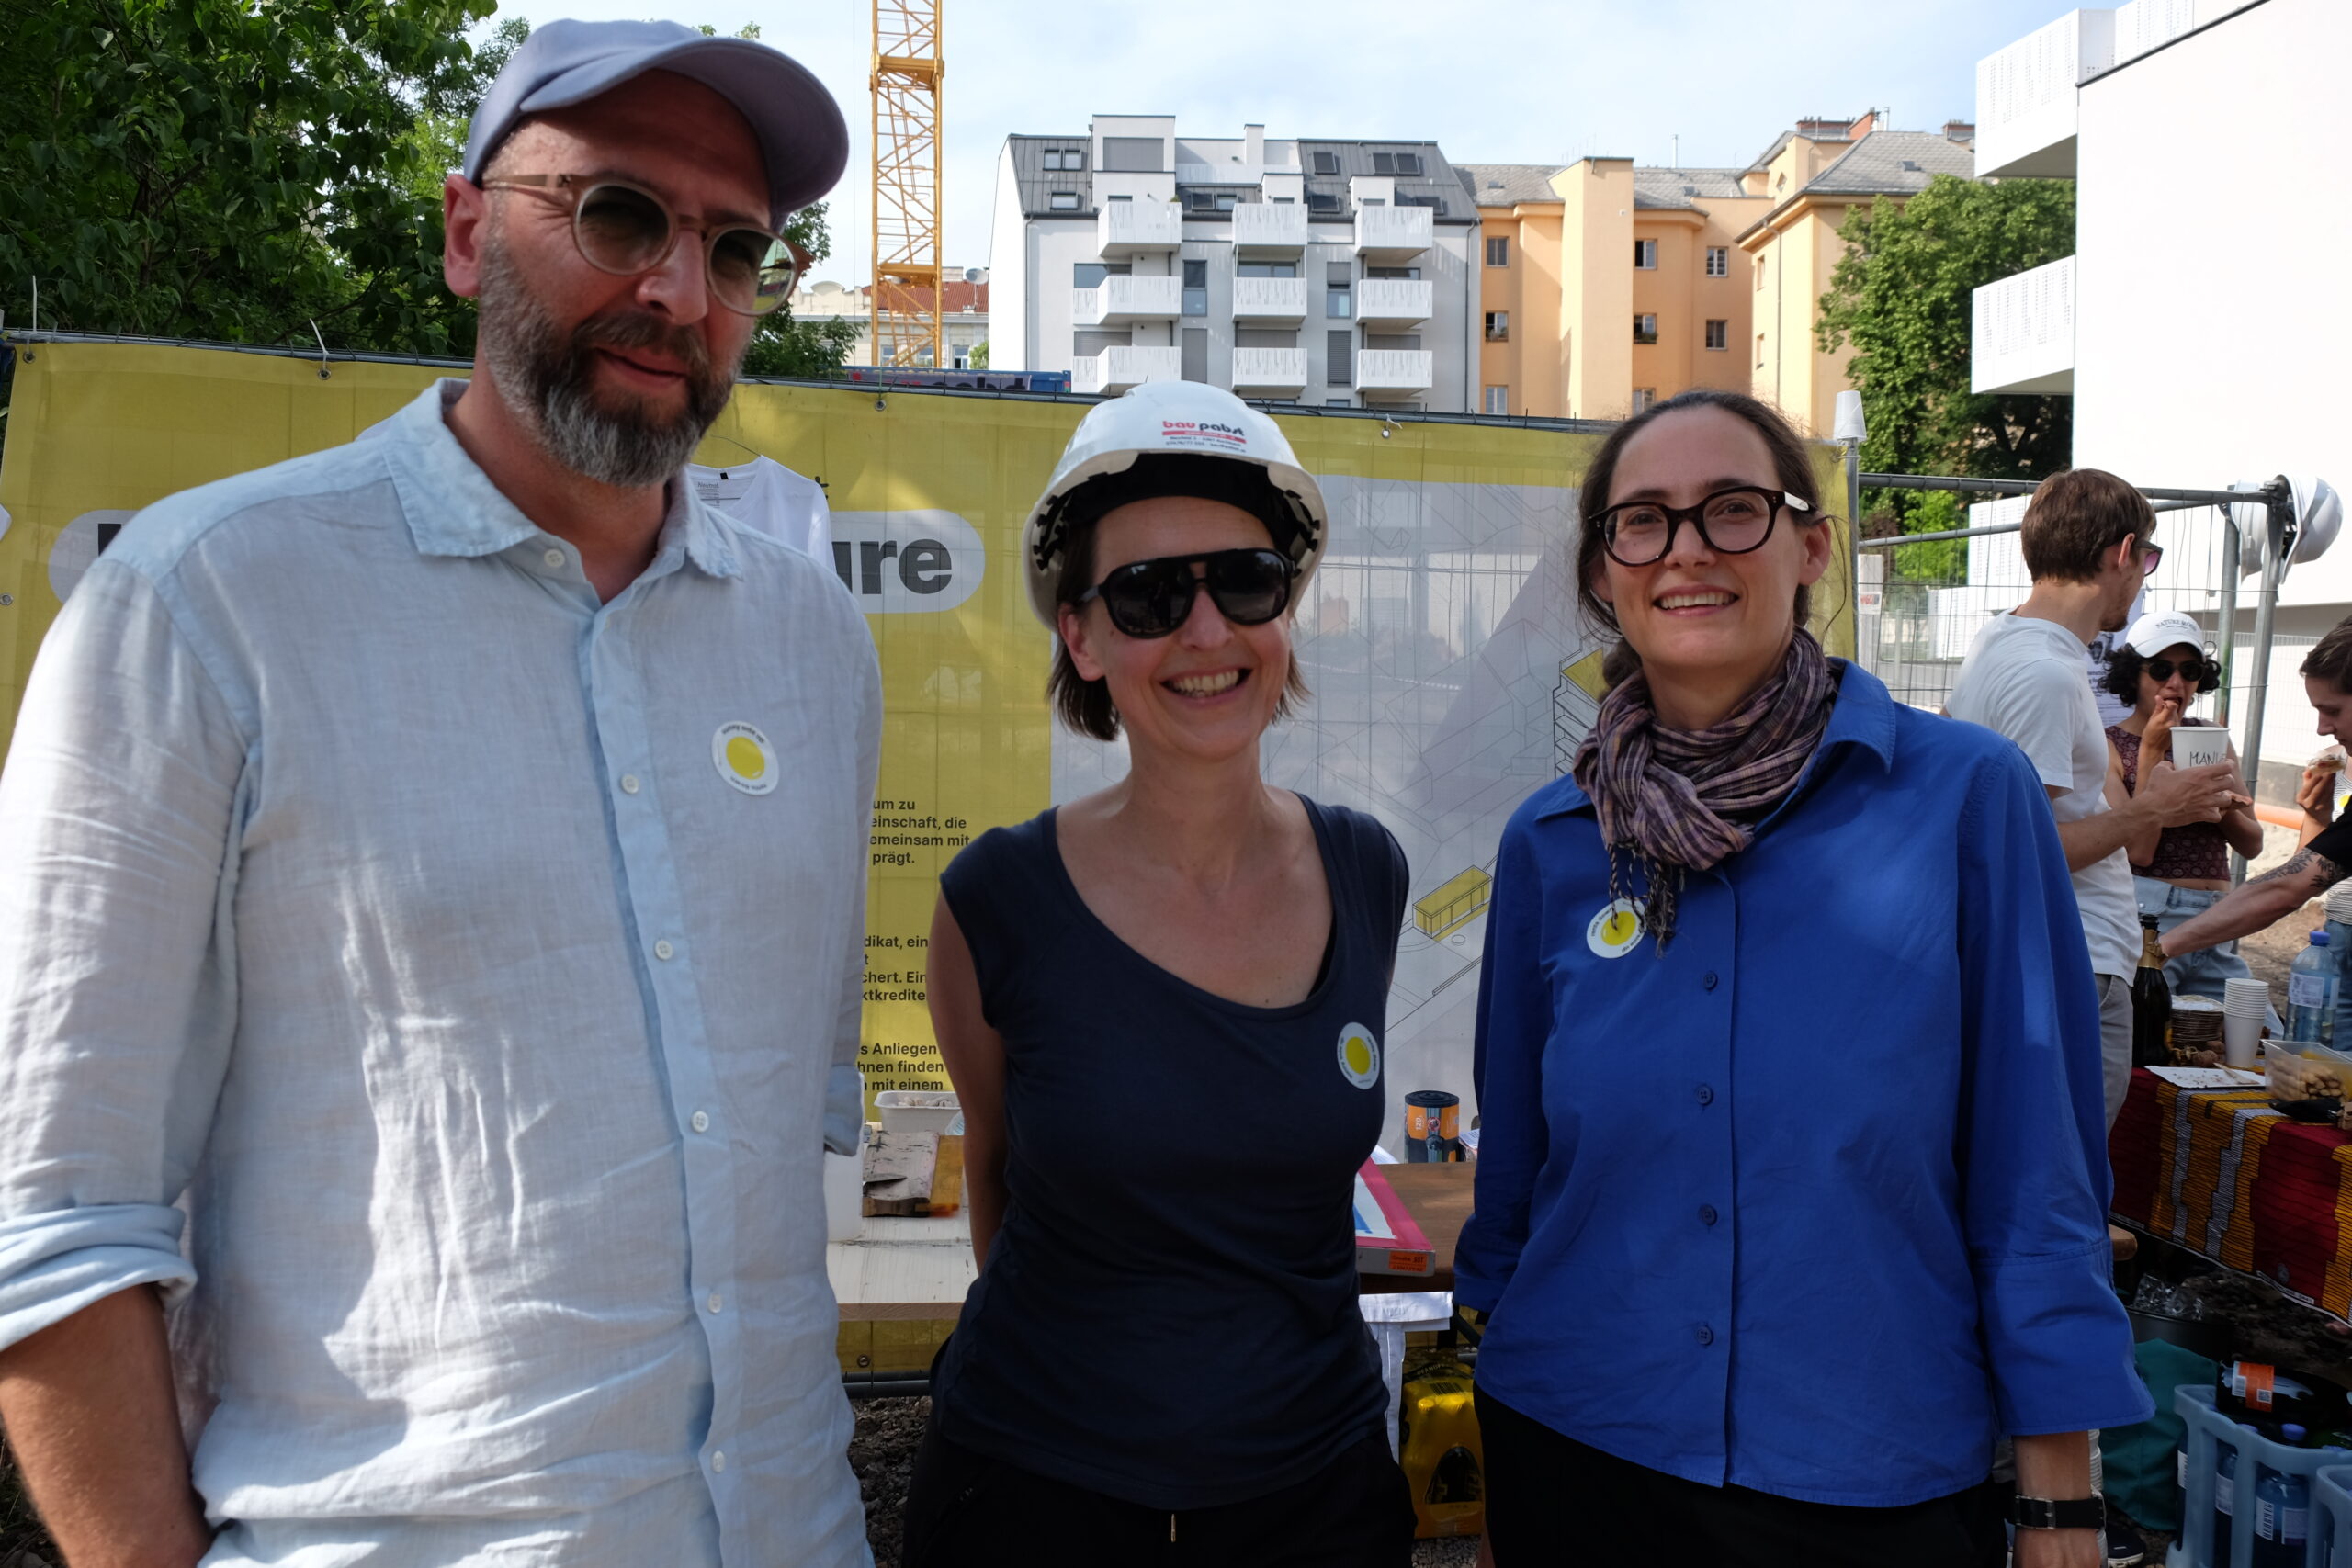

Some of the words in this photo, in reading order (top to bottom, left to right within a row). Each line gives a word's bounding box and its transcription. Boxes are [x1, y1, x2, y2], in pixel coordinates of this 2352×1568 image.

[1162, 421, 1195, 429] bau
[899, 800, 915, 810] zu
[871, 816, 942, 830] einschaft,
[944, 817, 967, 829] die
[870, 833, 944, 846] emeinsam
[947, 834, 970, 846] mit
[873, 851, 915, 866] prägt.
[865, 935, 903, 950] dikat,
[907, 936, 929, 947] ein
[860, 1046, 868, 1055] s
[857, 1061, 894, 1073] hnen
[898, 1060, 944, 1073] finden
[872, 1078, 895, 1091] mit
[899, 1078, 944, 1091] einem
